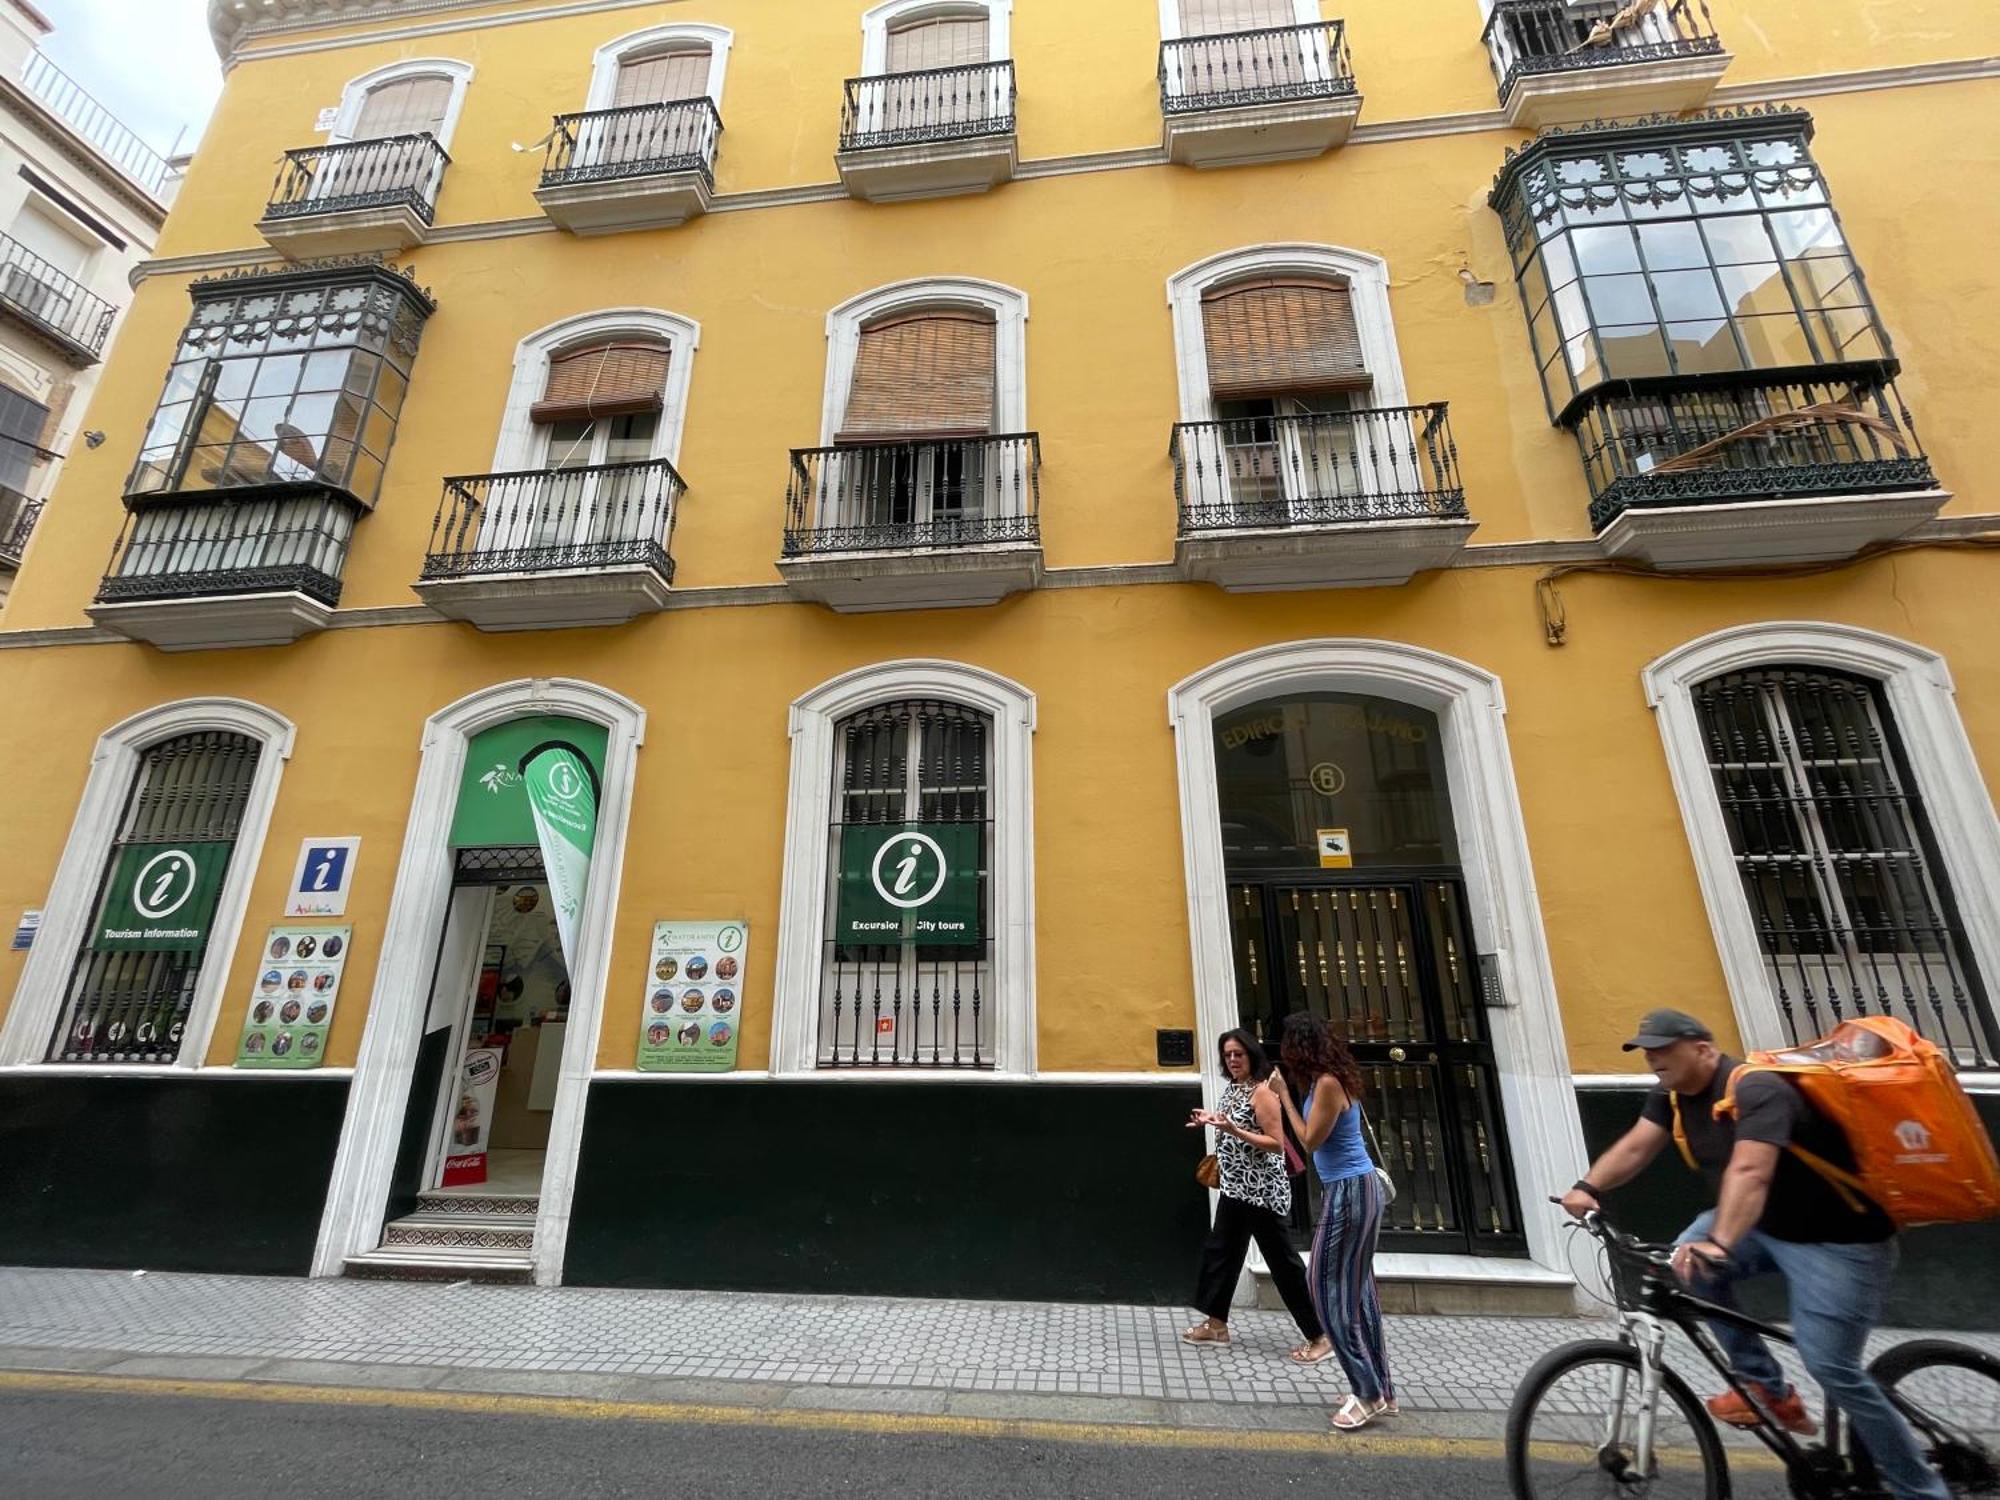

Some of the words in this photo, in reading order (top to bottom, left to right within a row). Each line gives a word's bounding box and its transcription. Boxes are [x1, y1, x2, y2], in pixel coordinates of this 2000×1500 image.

[1319, 768, 1334, 789] 6
[938, 921, 965, 931] tours
[104, 928, 142, 939] Tourism
